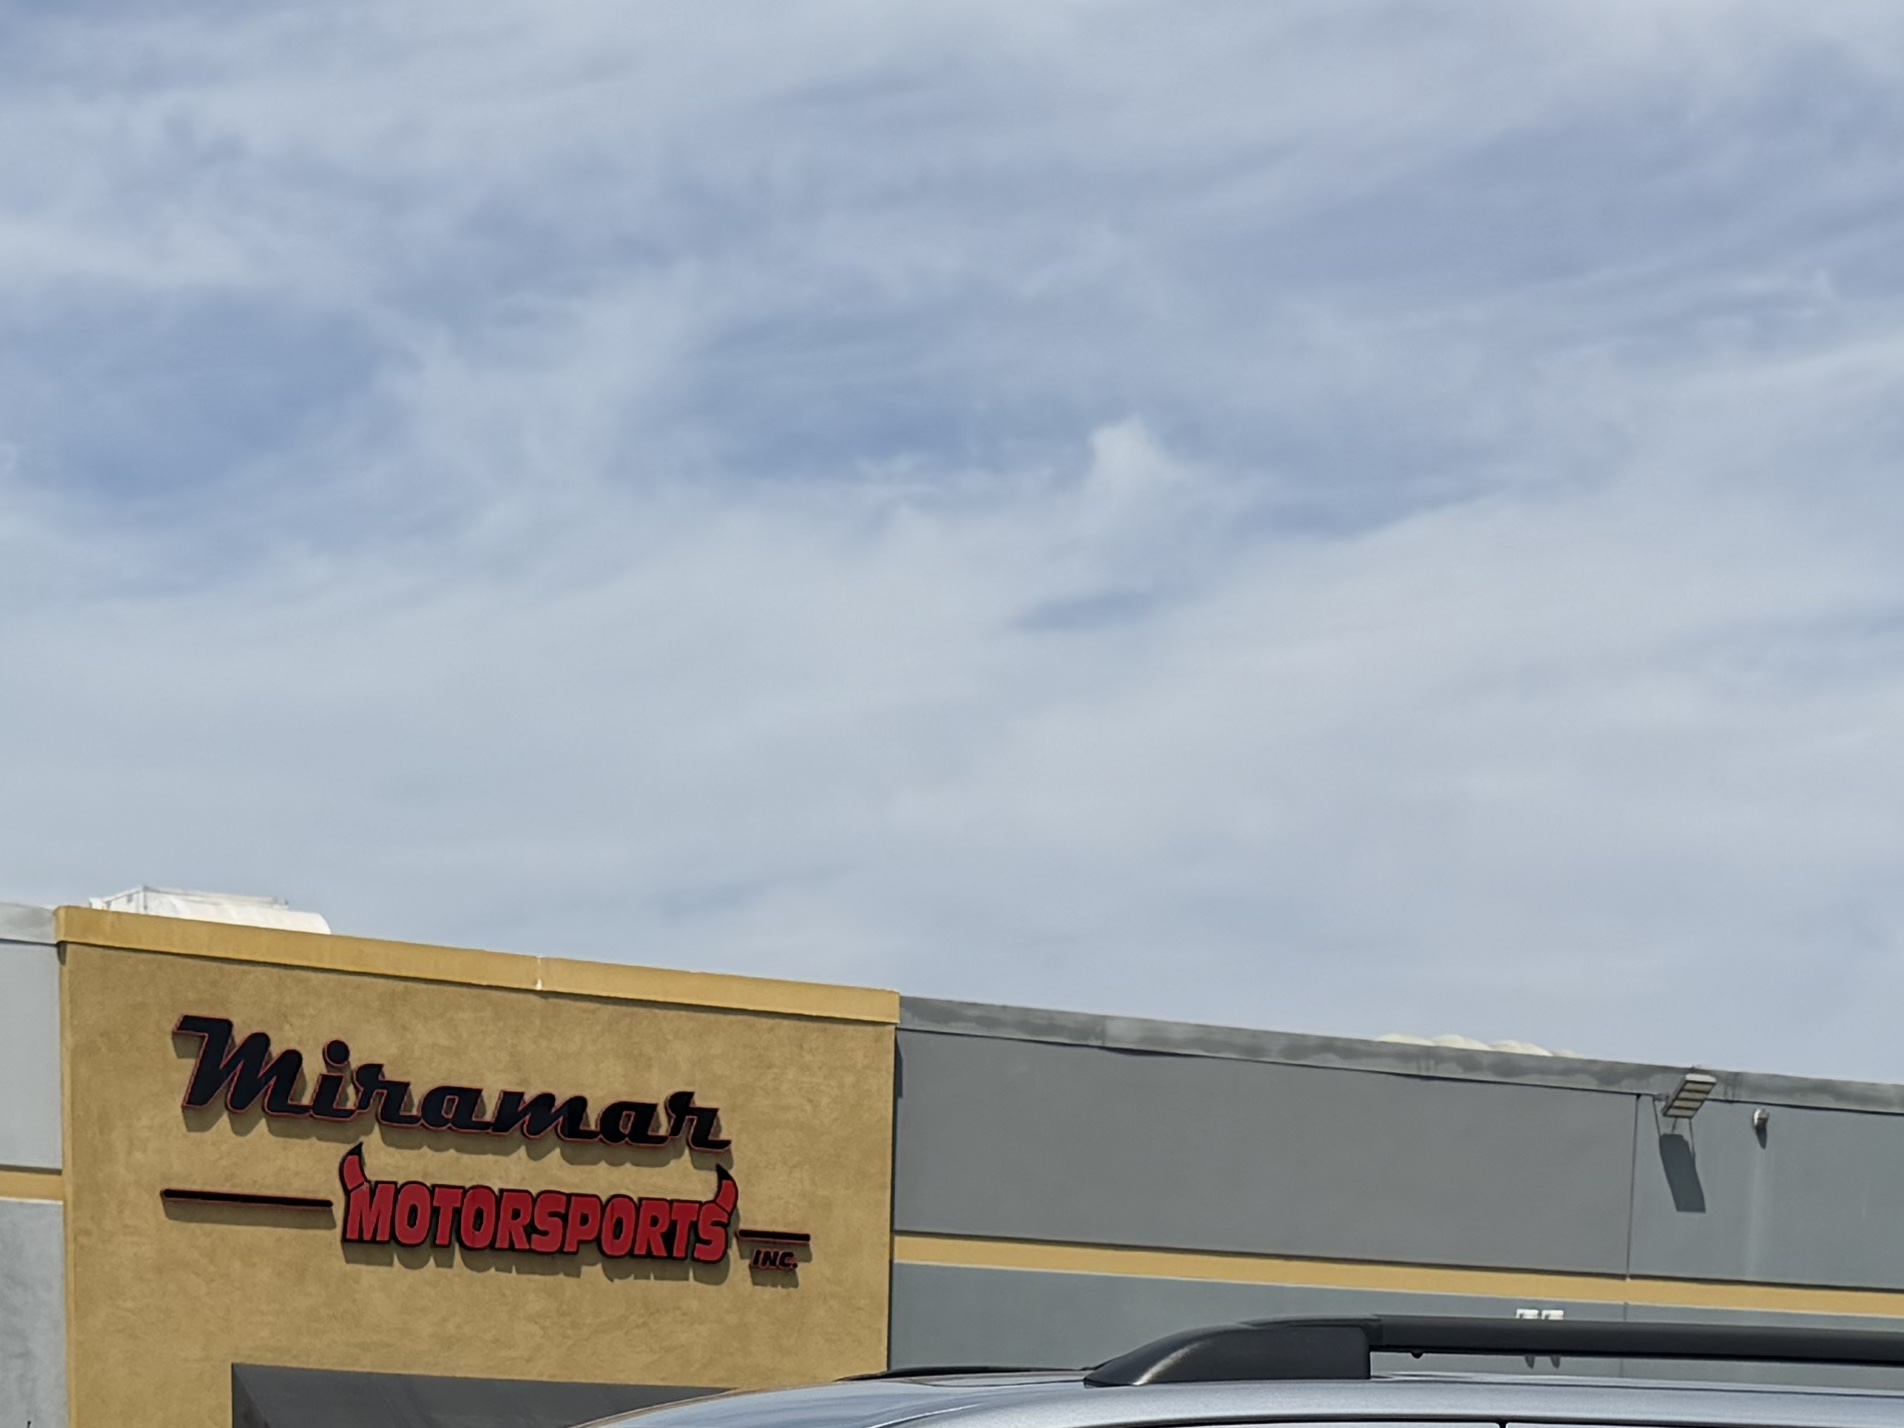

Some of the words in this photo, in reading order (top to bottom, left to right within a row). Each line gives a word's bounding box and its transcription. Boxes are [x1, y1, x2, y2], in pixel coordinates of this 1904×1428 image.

[173, 1014, 733, 1151] Miramar
[340, 1176, 737, 1263] MOTORSPORTS
[751, 1248, 799, 1269] INC.
